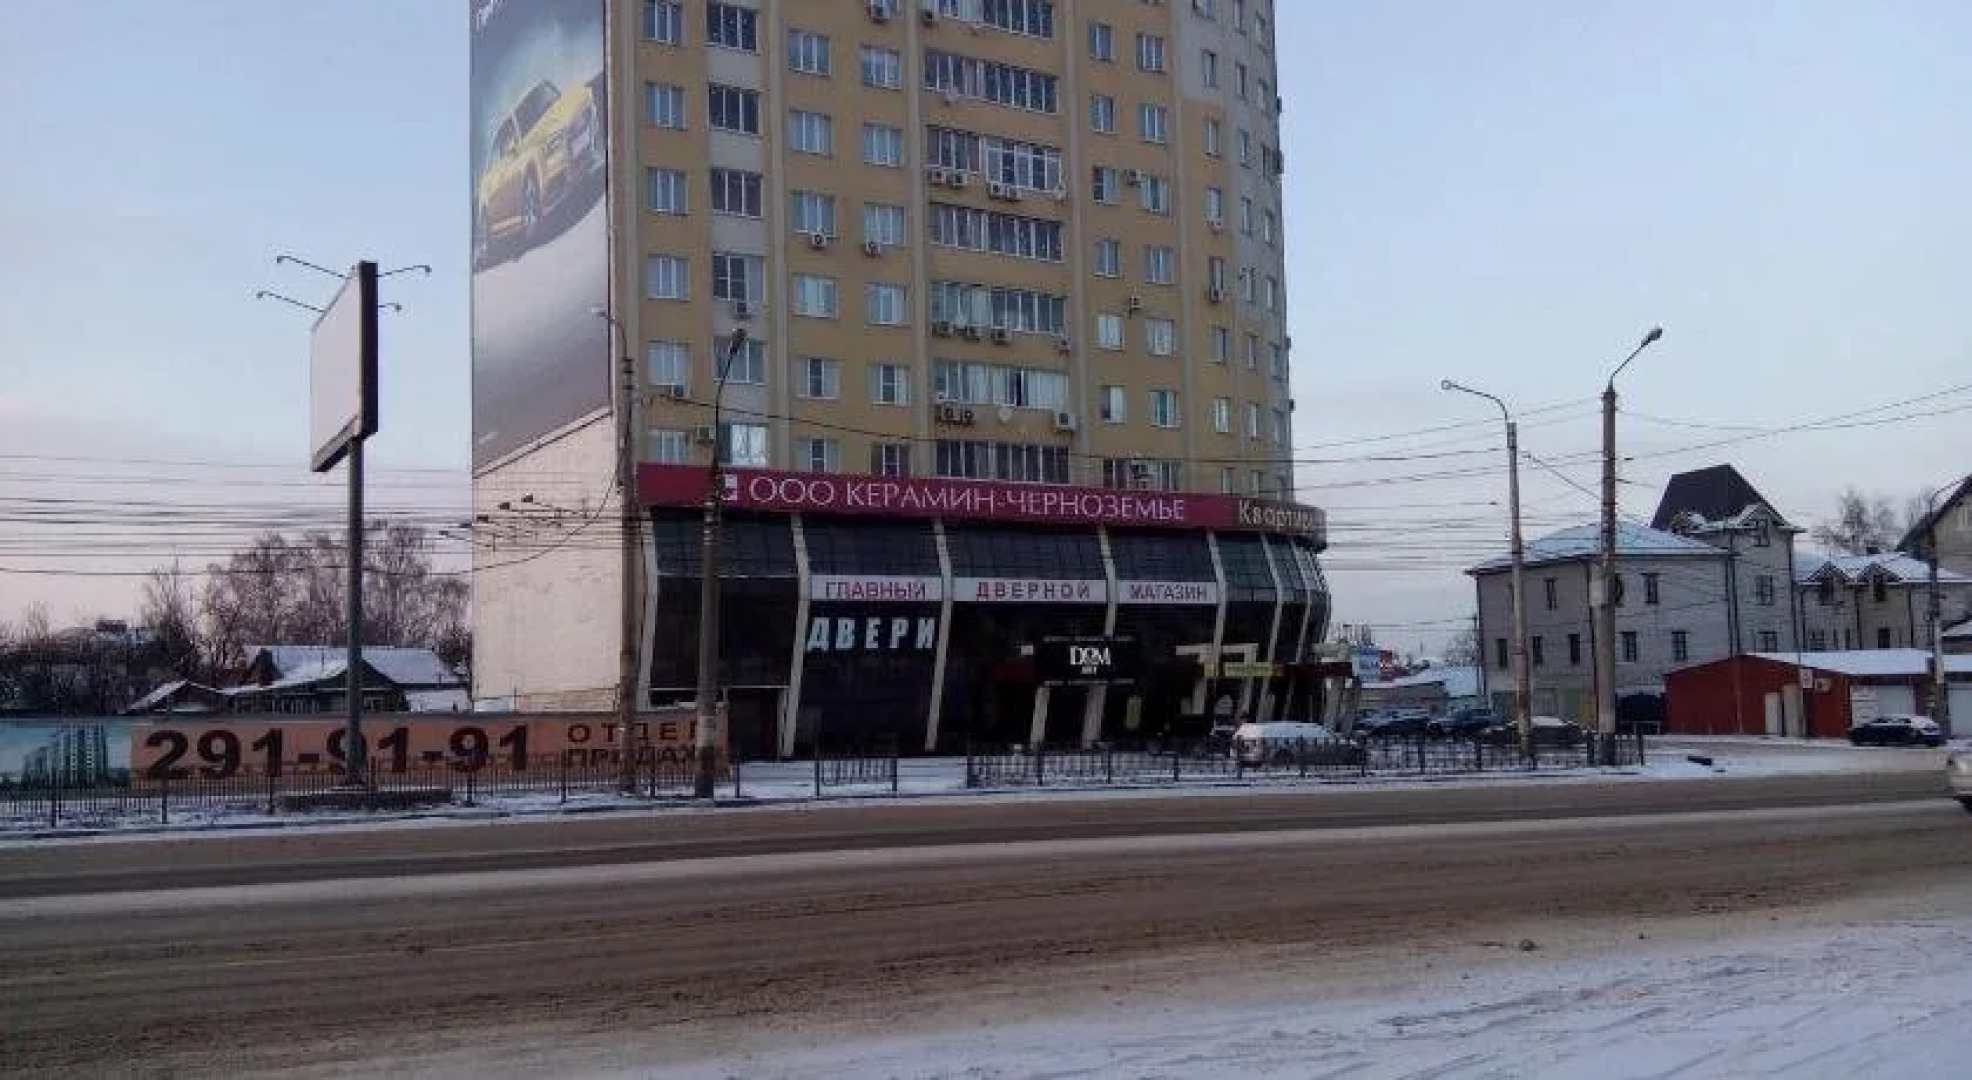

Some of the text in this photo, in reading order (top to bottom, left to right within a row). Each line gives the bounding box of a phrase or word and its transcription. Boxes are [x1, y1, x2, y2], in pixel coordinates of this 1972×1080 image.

[749, 475, 835, 506] ООО
[825, 579, 926, 600] ГЛАВНЫЙ
[976, 579, 1091, 600] ДВЕРНОЙ
[1130, 584, 1208, 602] МАГАЗИН
[807, 616, 936, 651] ДВЕРИ
[145, 725, 528, 780] 291-91-91
